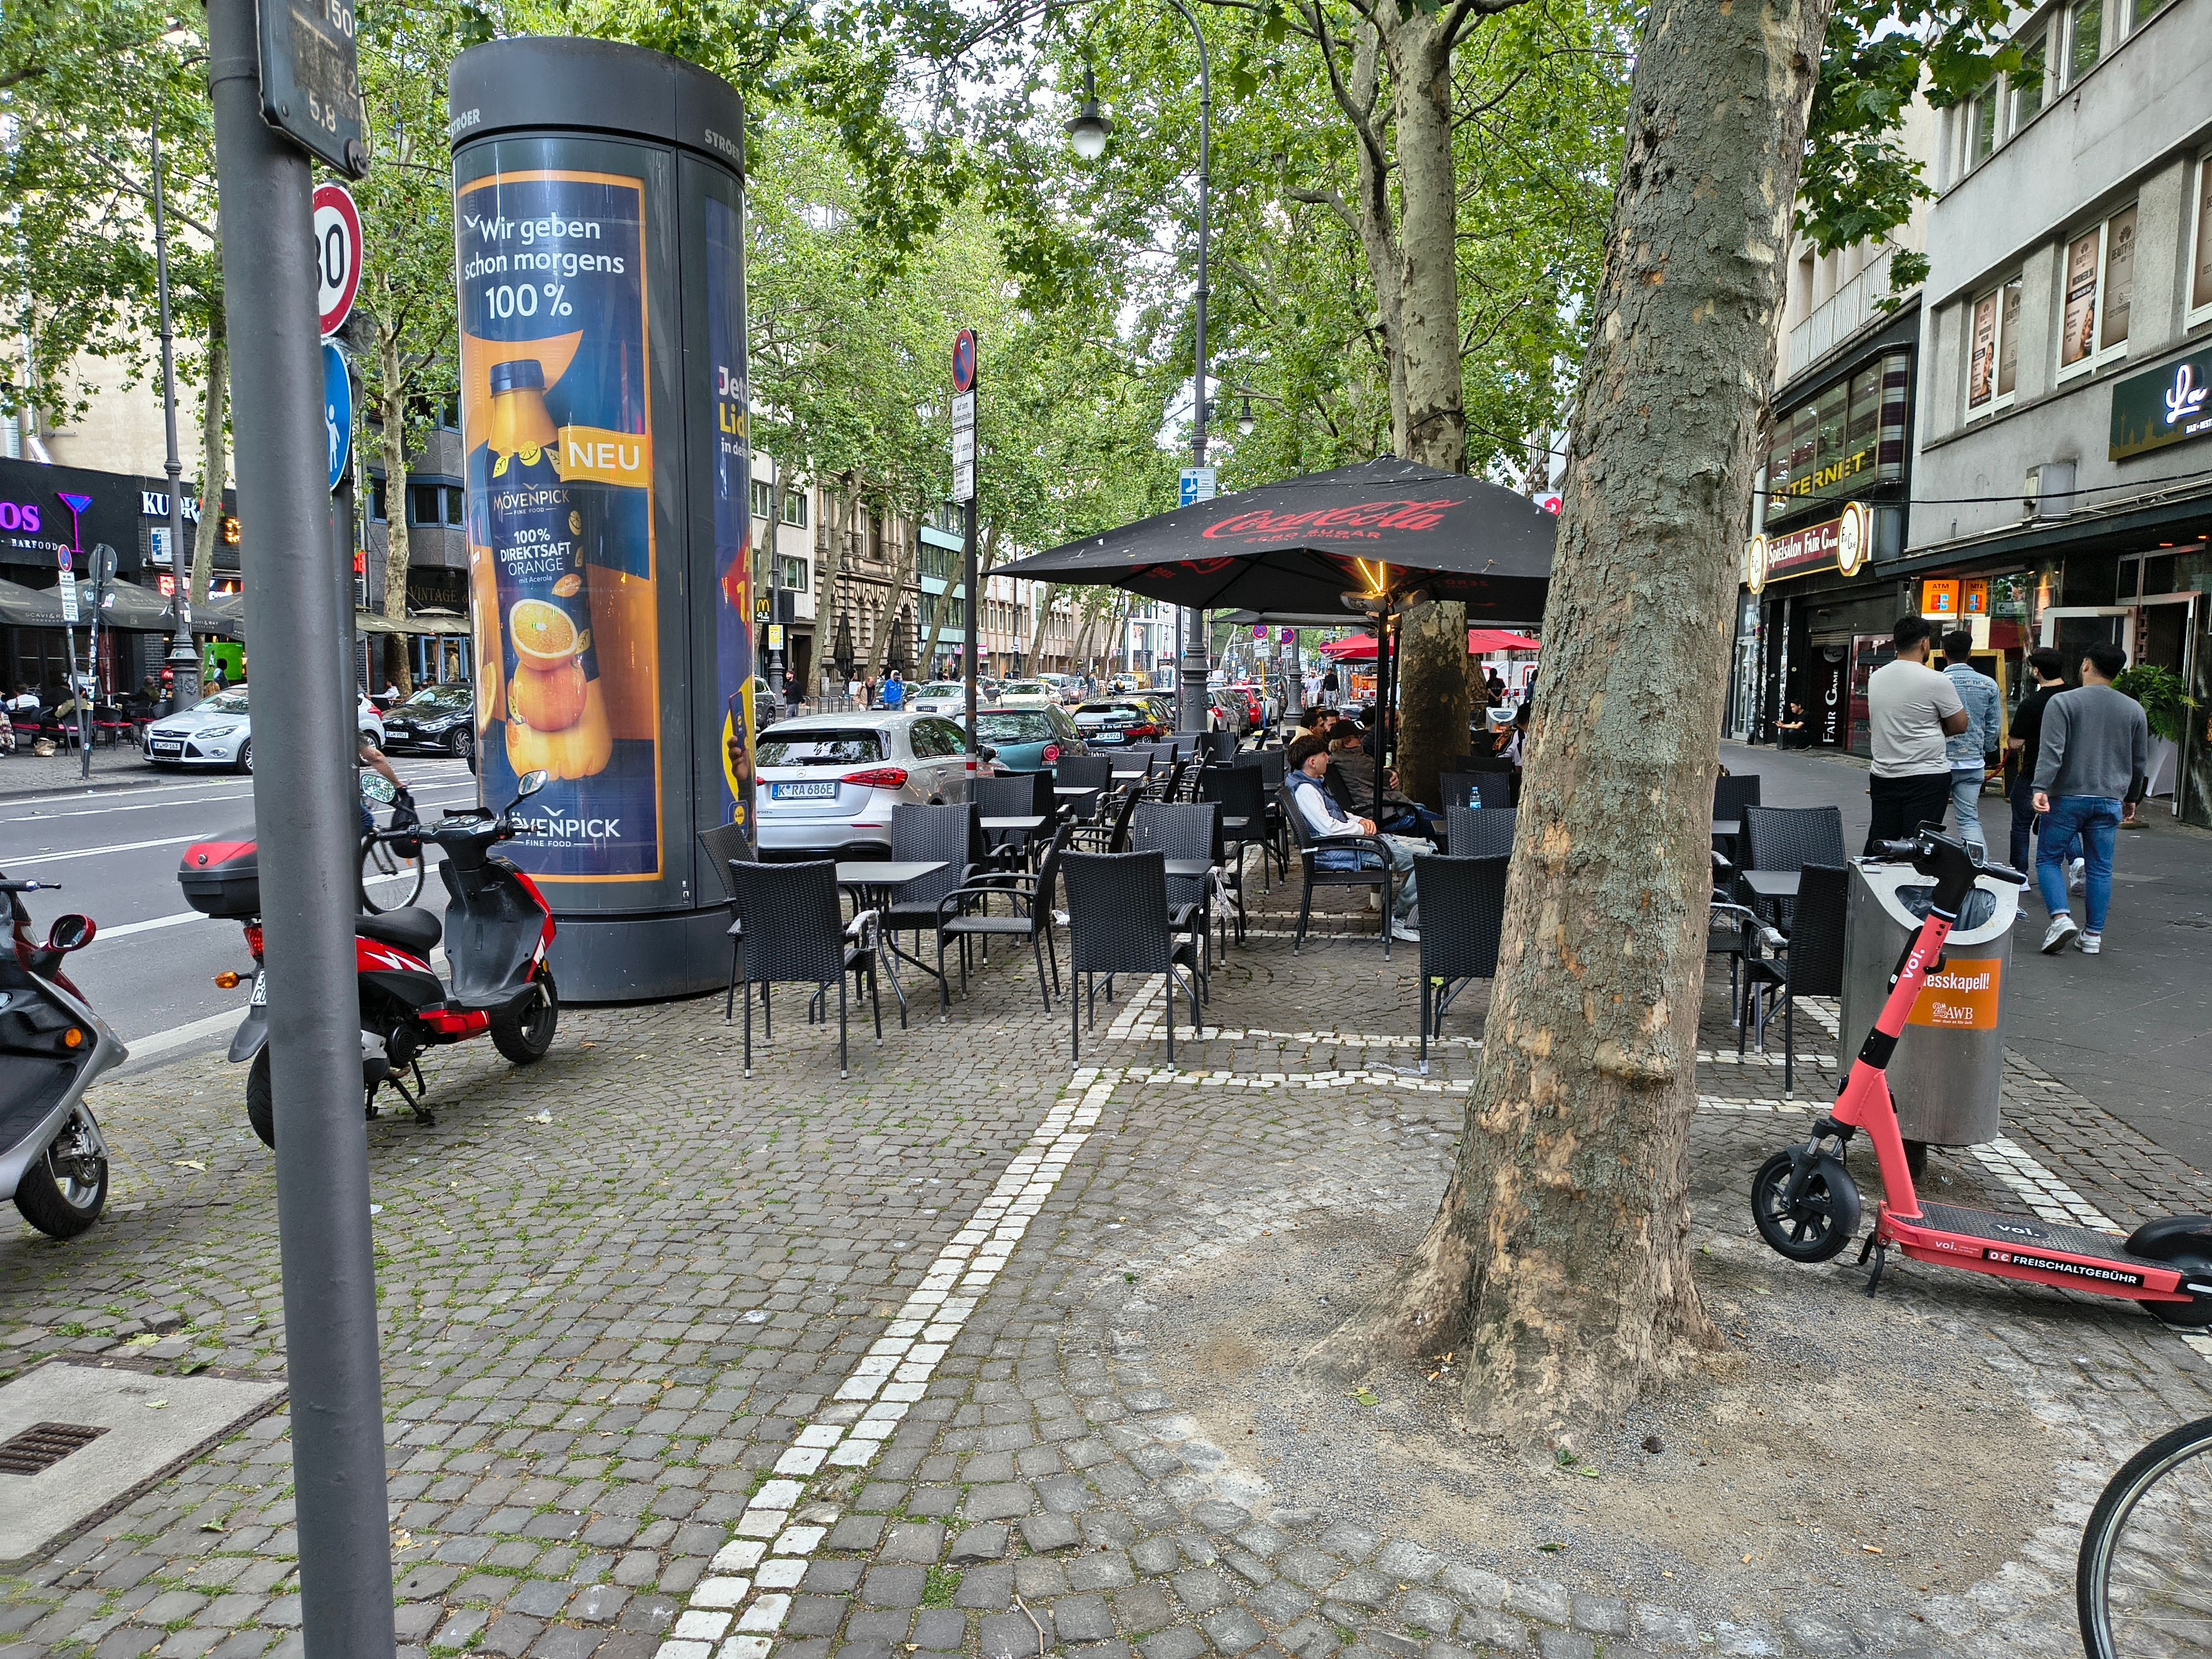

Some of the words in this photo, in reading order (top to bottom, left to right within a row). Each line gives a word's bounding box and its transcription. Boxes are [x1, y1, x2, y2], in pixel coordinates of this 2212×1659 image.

[705, 128, 740, 164] STRÖER
[479, 216, 514, 242] Wir
[521, 212, 601, 245] geben
[465, 252, 508, 280] schon
[514, 253, 625, 277] morgens
[721, 437, 731, 453] in
[568, 442, 640, 471] NEU
[494, 489, 570, 511] MÖVENPICK
[1307, 529, 1381, 540] SUGAR
[500, 541, 571, 562] DIREKTSAFT
[508, 557, 564, 576] ORANGE
[529, 574, 552, 583] Acerola
[409, 585, 457, 603] VINTAGE
[779, 786, 785, 795] K
[792, 785, 805, 795] RA
[807, 784, 833, 795] 686E
[496, 811, 621, 838] ÖVENPICK
[1923, 972, 1990, 994] esskapell!
[1946, 1006, 1973, 1020] AWB
[1935, 1240, 1958, 1251] voi.
[1990, 1251, 1999, 1260] 0
[2000, 1253, 2010, 1262] €
[2013, 1255, 2138, 1284] FREISCHALTGEBÜHR
